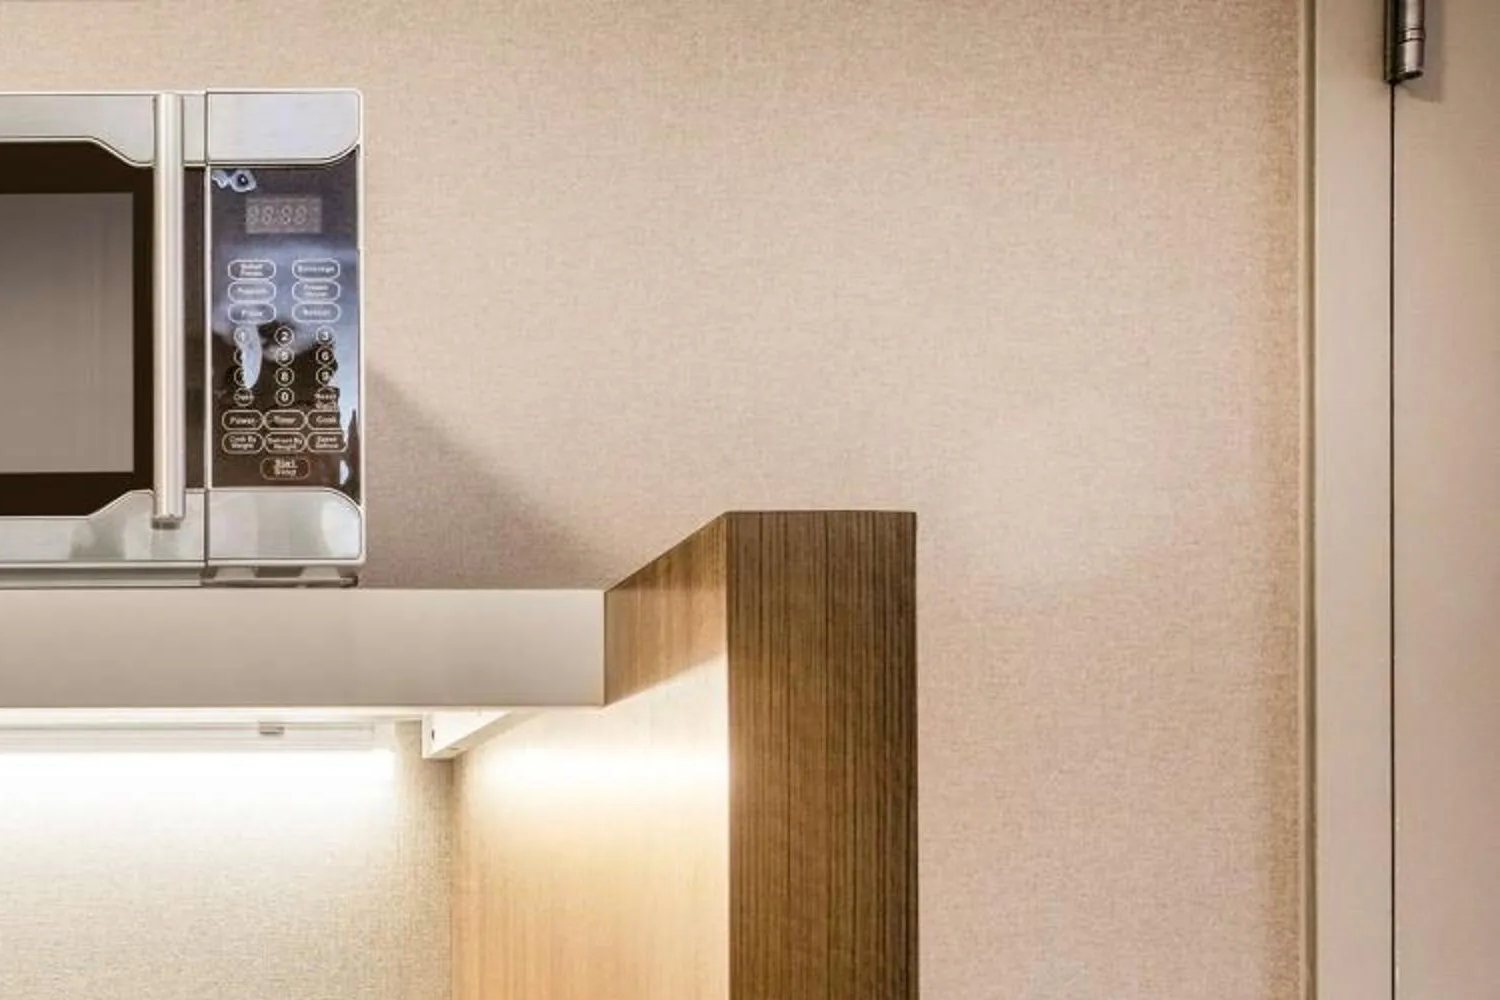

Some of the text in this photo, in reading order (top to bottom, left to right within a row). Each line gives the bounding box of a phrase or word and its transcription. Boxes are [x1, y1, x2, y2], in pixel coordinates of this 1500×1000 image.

[280, 330, 289, 342] 2
[320, 330, 330, 342] 3
[320, 350, 330, 361] 6
[280, 370, 289, 382] 8
[280, 391, 289, 402] 0
